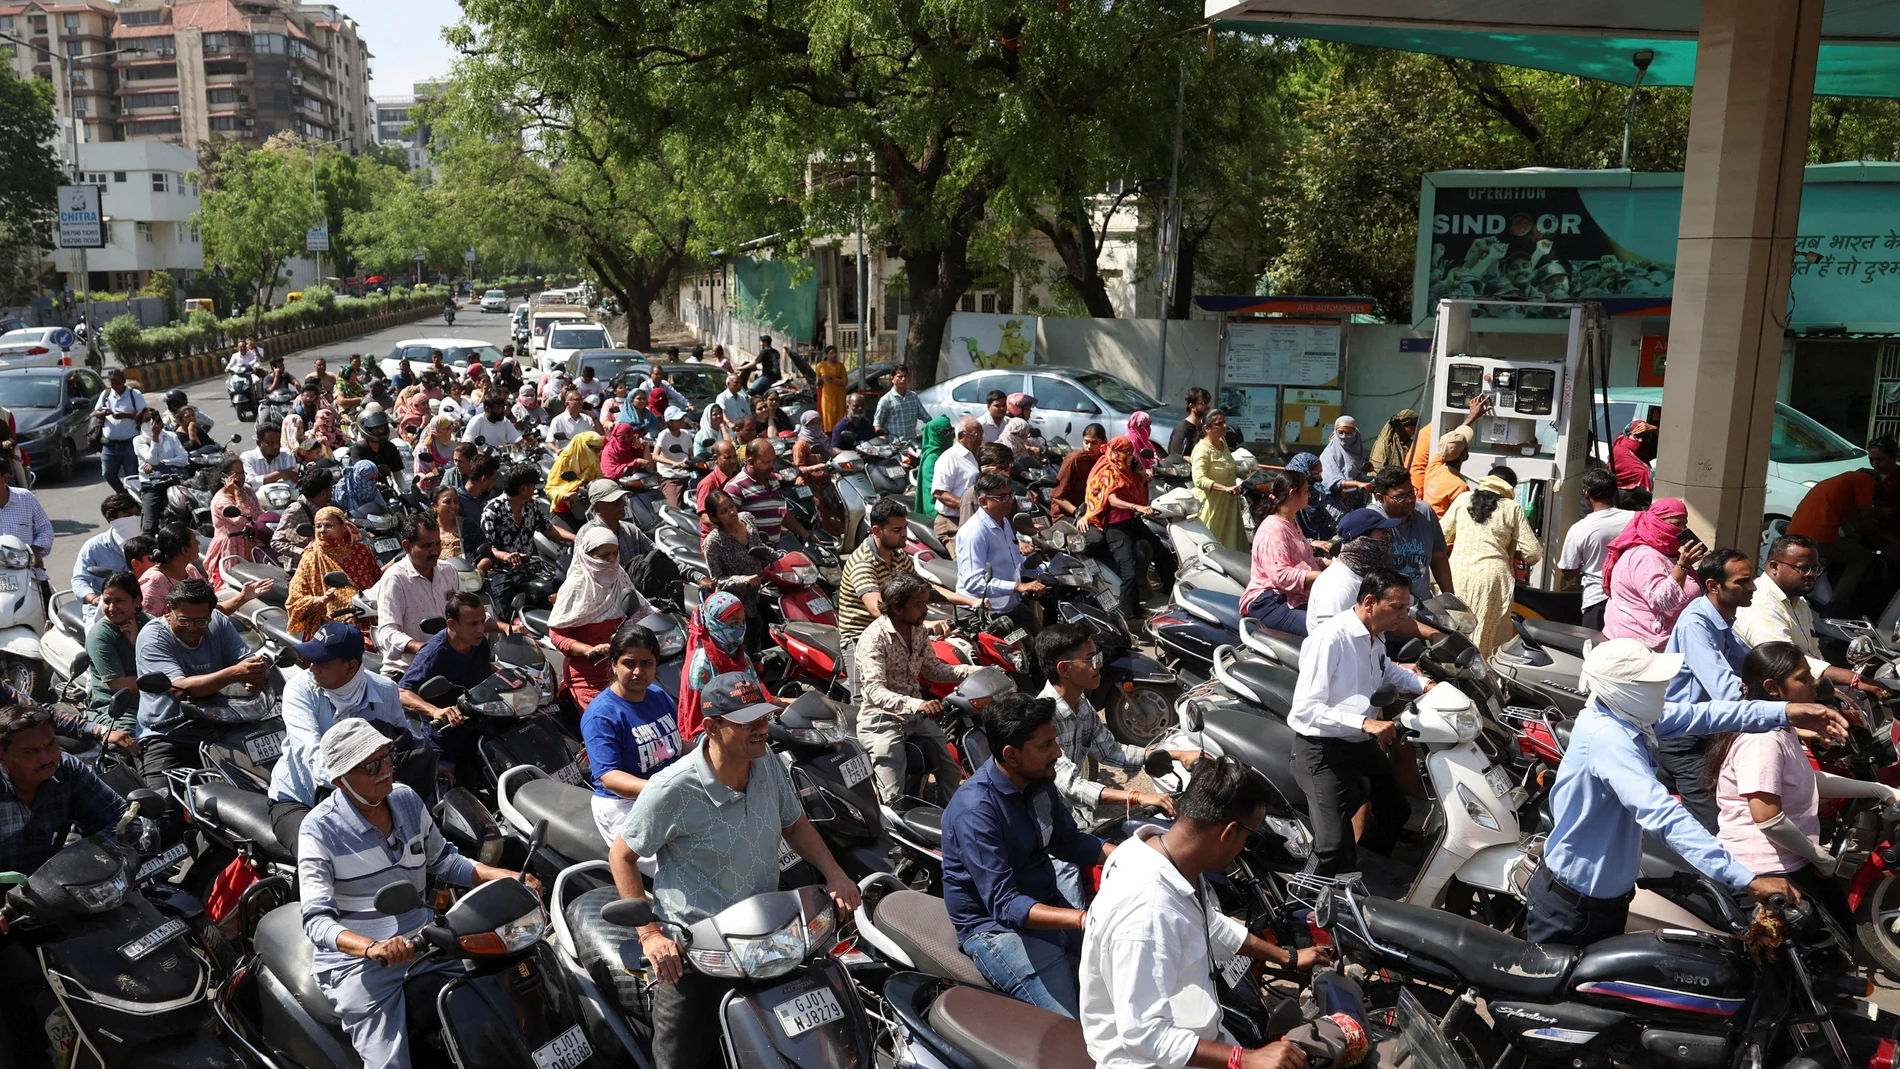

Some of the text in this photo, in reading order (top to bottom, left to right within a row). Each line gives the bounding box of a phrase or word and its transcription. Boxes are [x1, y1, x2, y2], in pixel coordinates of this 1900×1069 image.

[1468, 187, 1546, 200] OPERATION
[61, 212, 97, 222] CHITRA
[1829, 234, 1880, 252] भारत
[1836, 255, 1862, 276] तो
[245, 730, 266, 739] HONDA
[254, 733, 281, 748] GJ01X
[846, 756, 865, 773] GJ01X
[558, 765, 574, 780] GJ01
[782, 980, 814, 994] HONDA
[794, 990, 826, 1012] GJ01
[552, 1030, 580, 1056] GJ01
